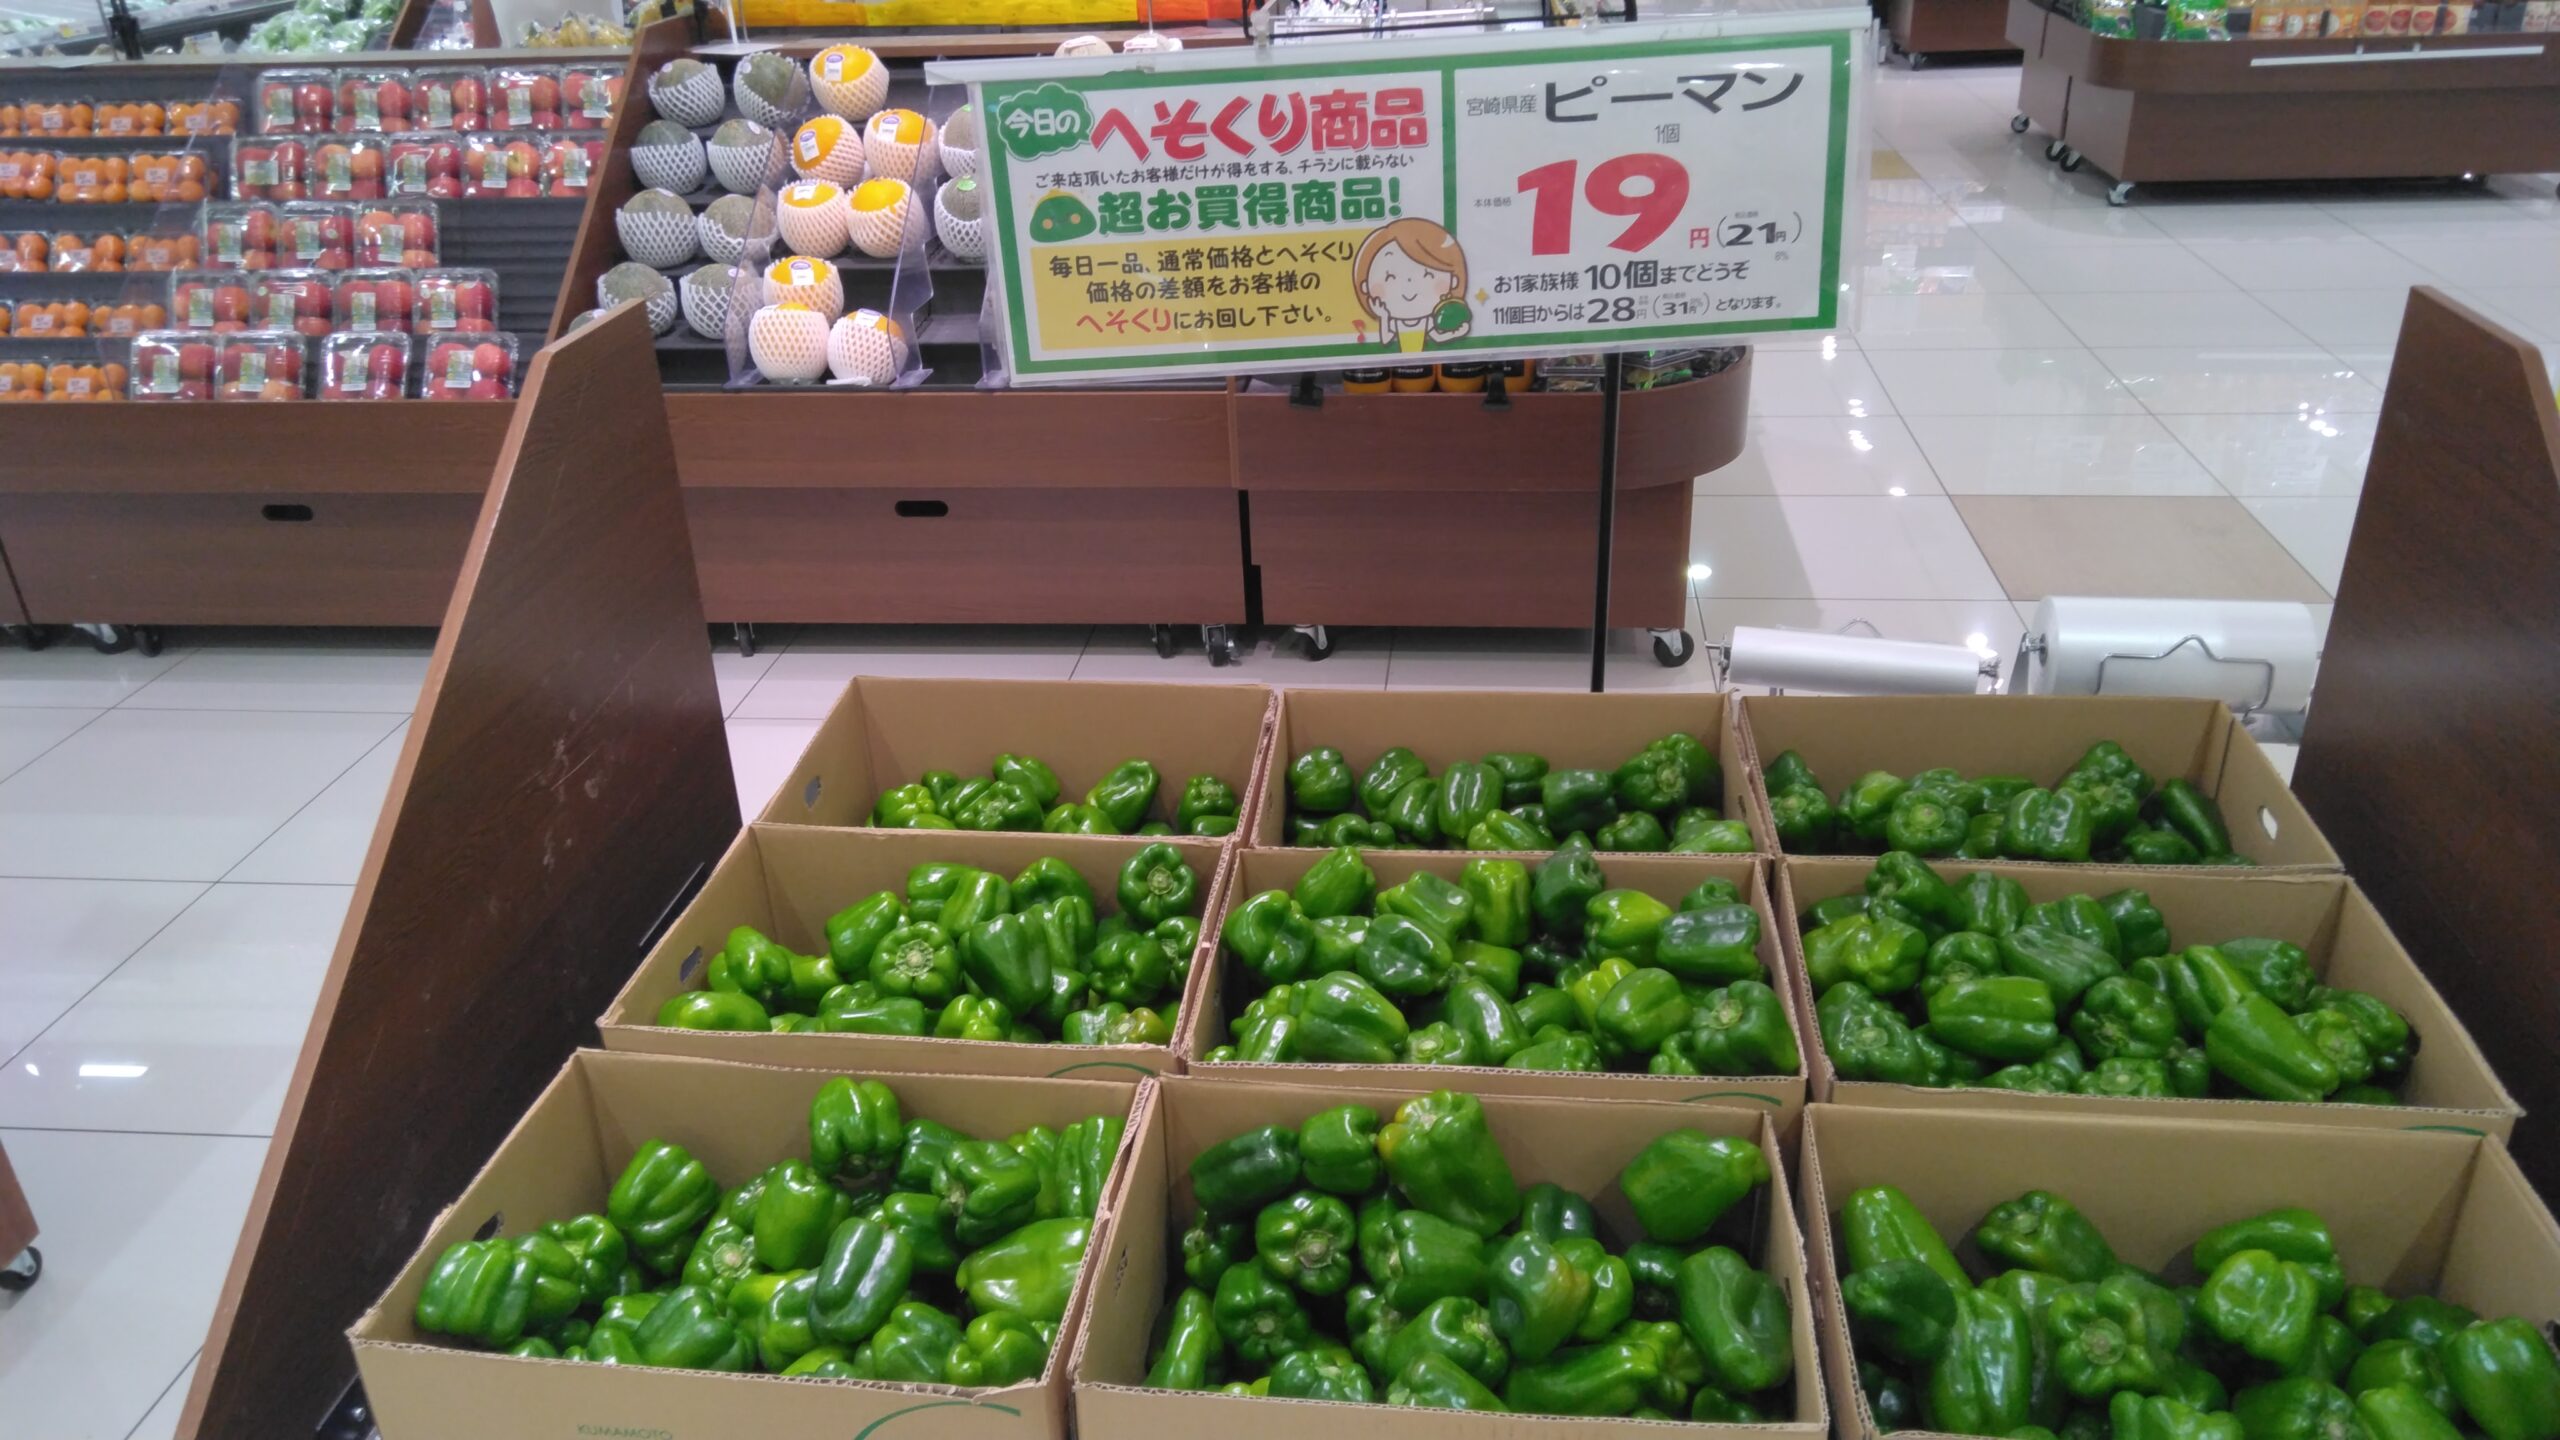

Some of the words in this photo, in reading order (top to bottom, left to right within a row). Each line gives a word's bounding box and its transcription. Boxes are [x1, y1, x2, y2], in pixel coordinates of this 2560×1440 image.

[1545, 72, 1805, 123] ピーマン
[1004, 107, 1082, 139] 今日の
[1090, 87, 1429, 163] へそくり商品
[1048, 241, 1355, 279] 毎日一品、通常価格とへそくり
[1085, 270, 1322, 304] 価格の差額をお客様の
[1076, 303, 1333, 335] へそくりにお回し下さい。
